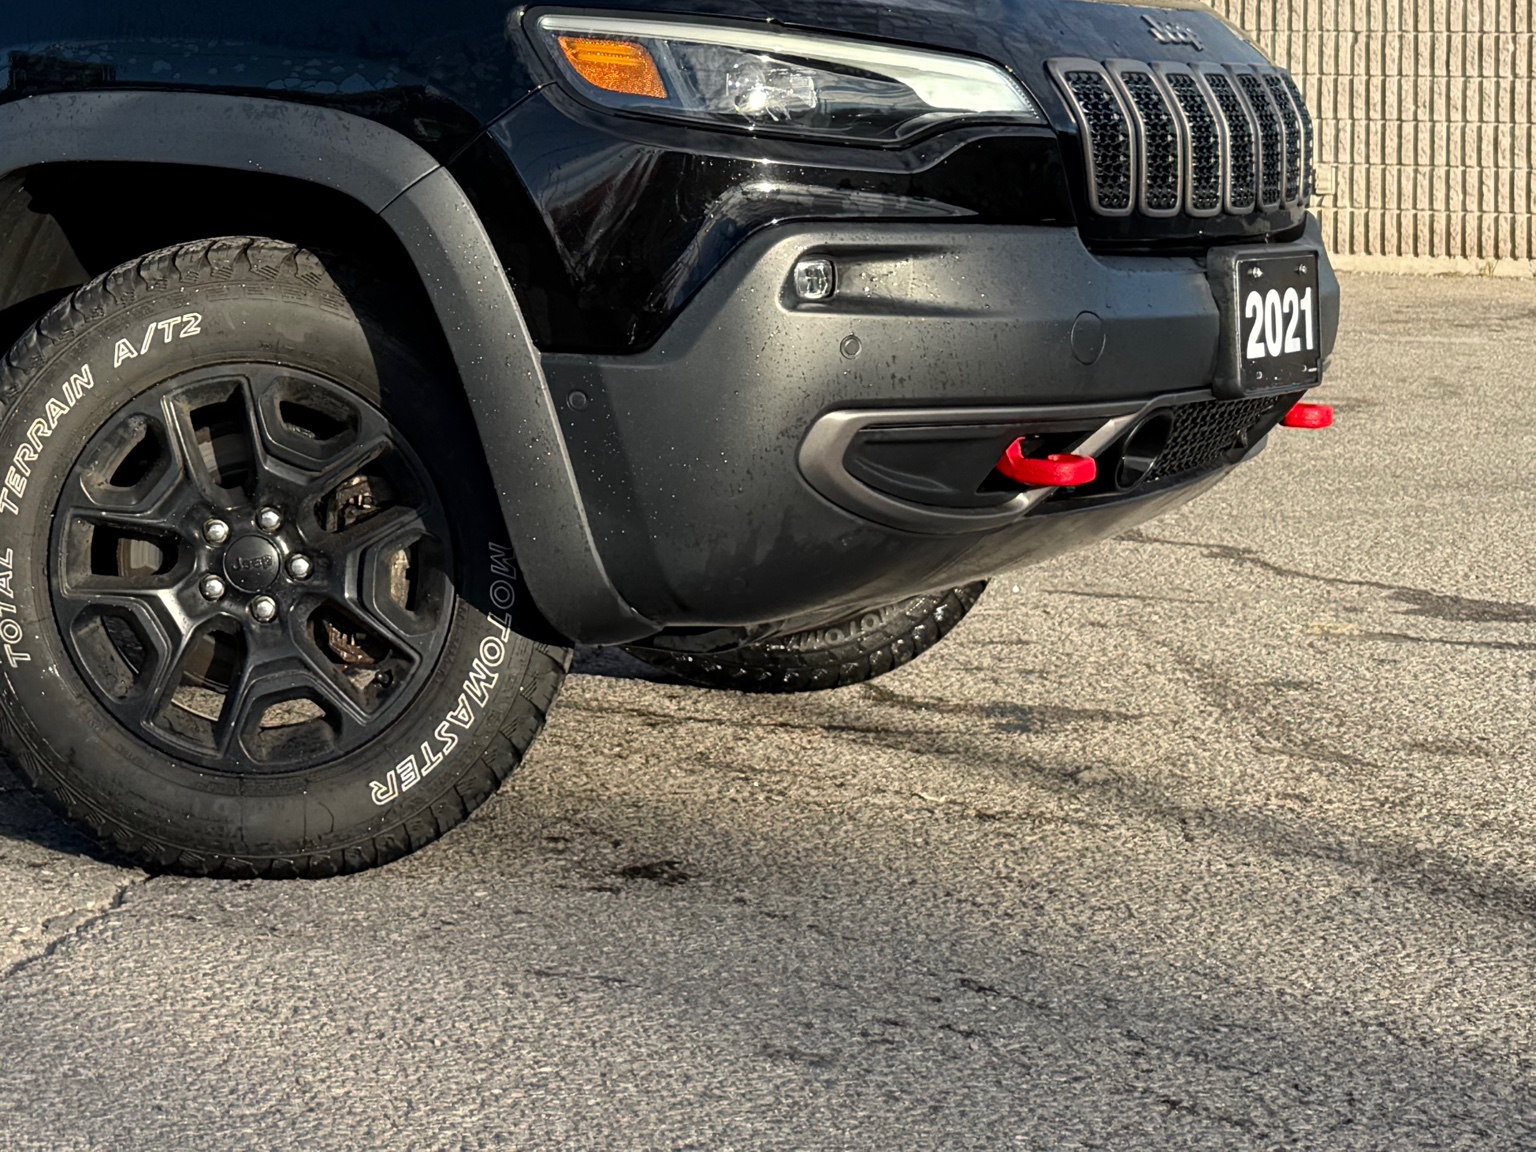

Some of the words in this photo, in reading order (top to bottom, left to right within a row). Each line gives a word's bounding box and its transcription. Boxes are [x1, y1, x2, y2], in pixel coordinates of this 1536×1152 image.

[113, 312, 203, 369] A/T2
[1244, 286, 1315, 360] 2021
[231, 555, 273, 571] Jeep
[368, 540, 518, 806] MOTOMASTER
